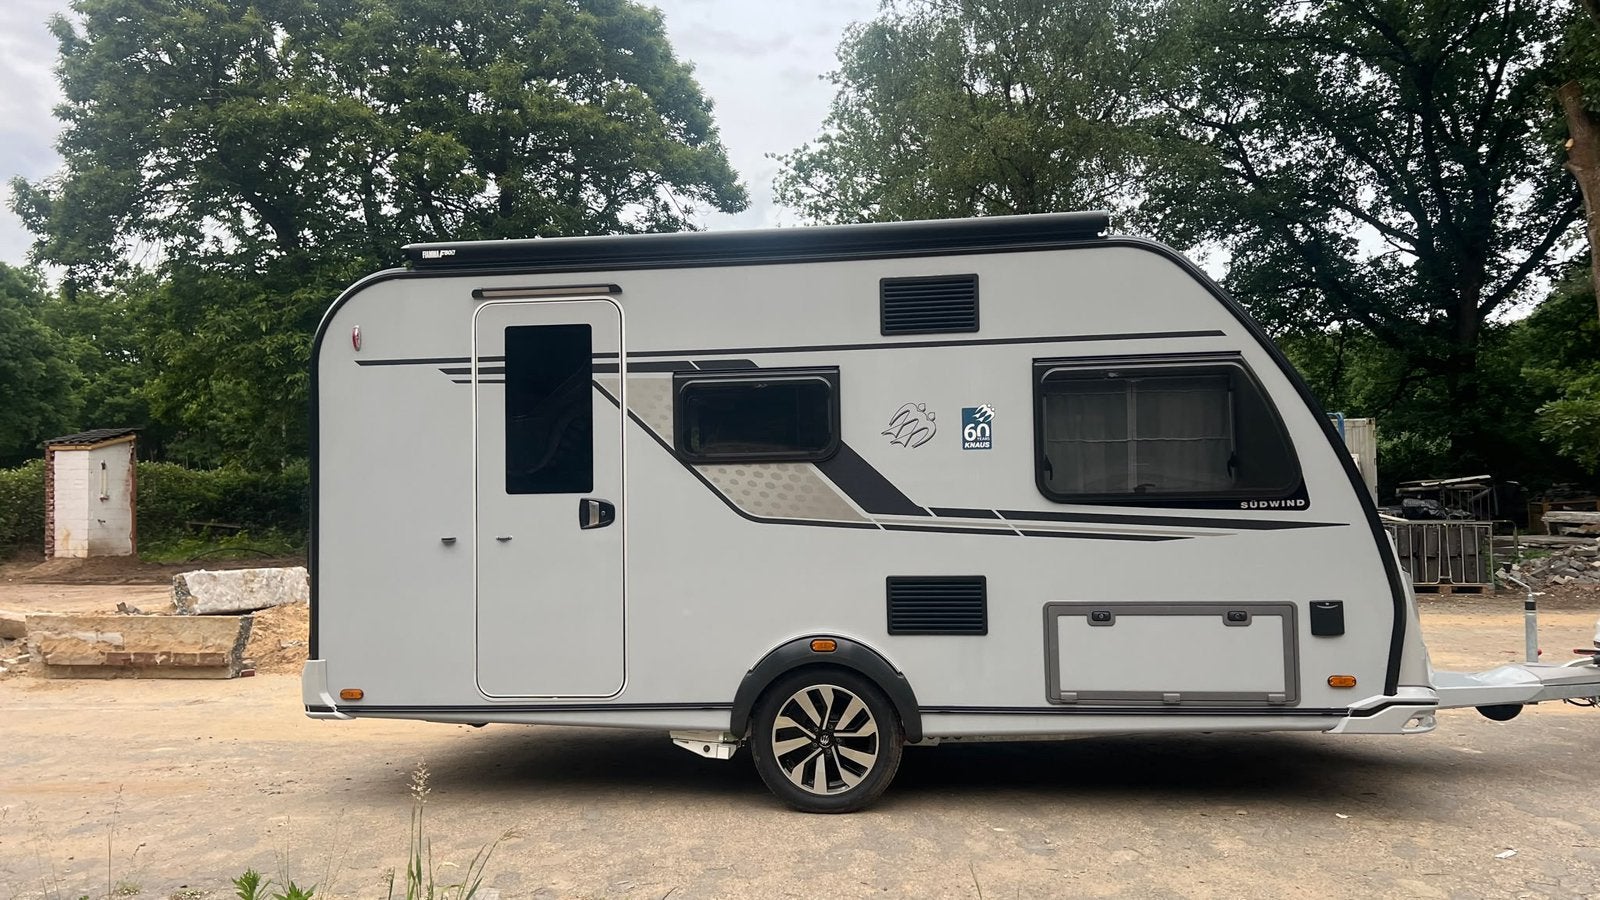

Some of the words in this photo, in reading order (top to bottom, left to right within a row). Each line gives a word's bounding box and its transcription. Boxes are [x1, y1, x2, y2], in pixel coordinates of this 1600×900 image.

[964, 423, 990, 441] 60
[964, 441, 990, 449] KNAUS
[1240, 499, 1305, 509] SÜDWIND
